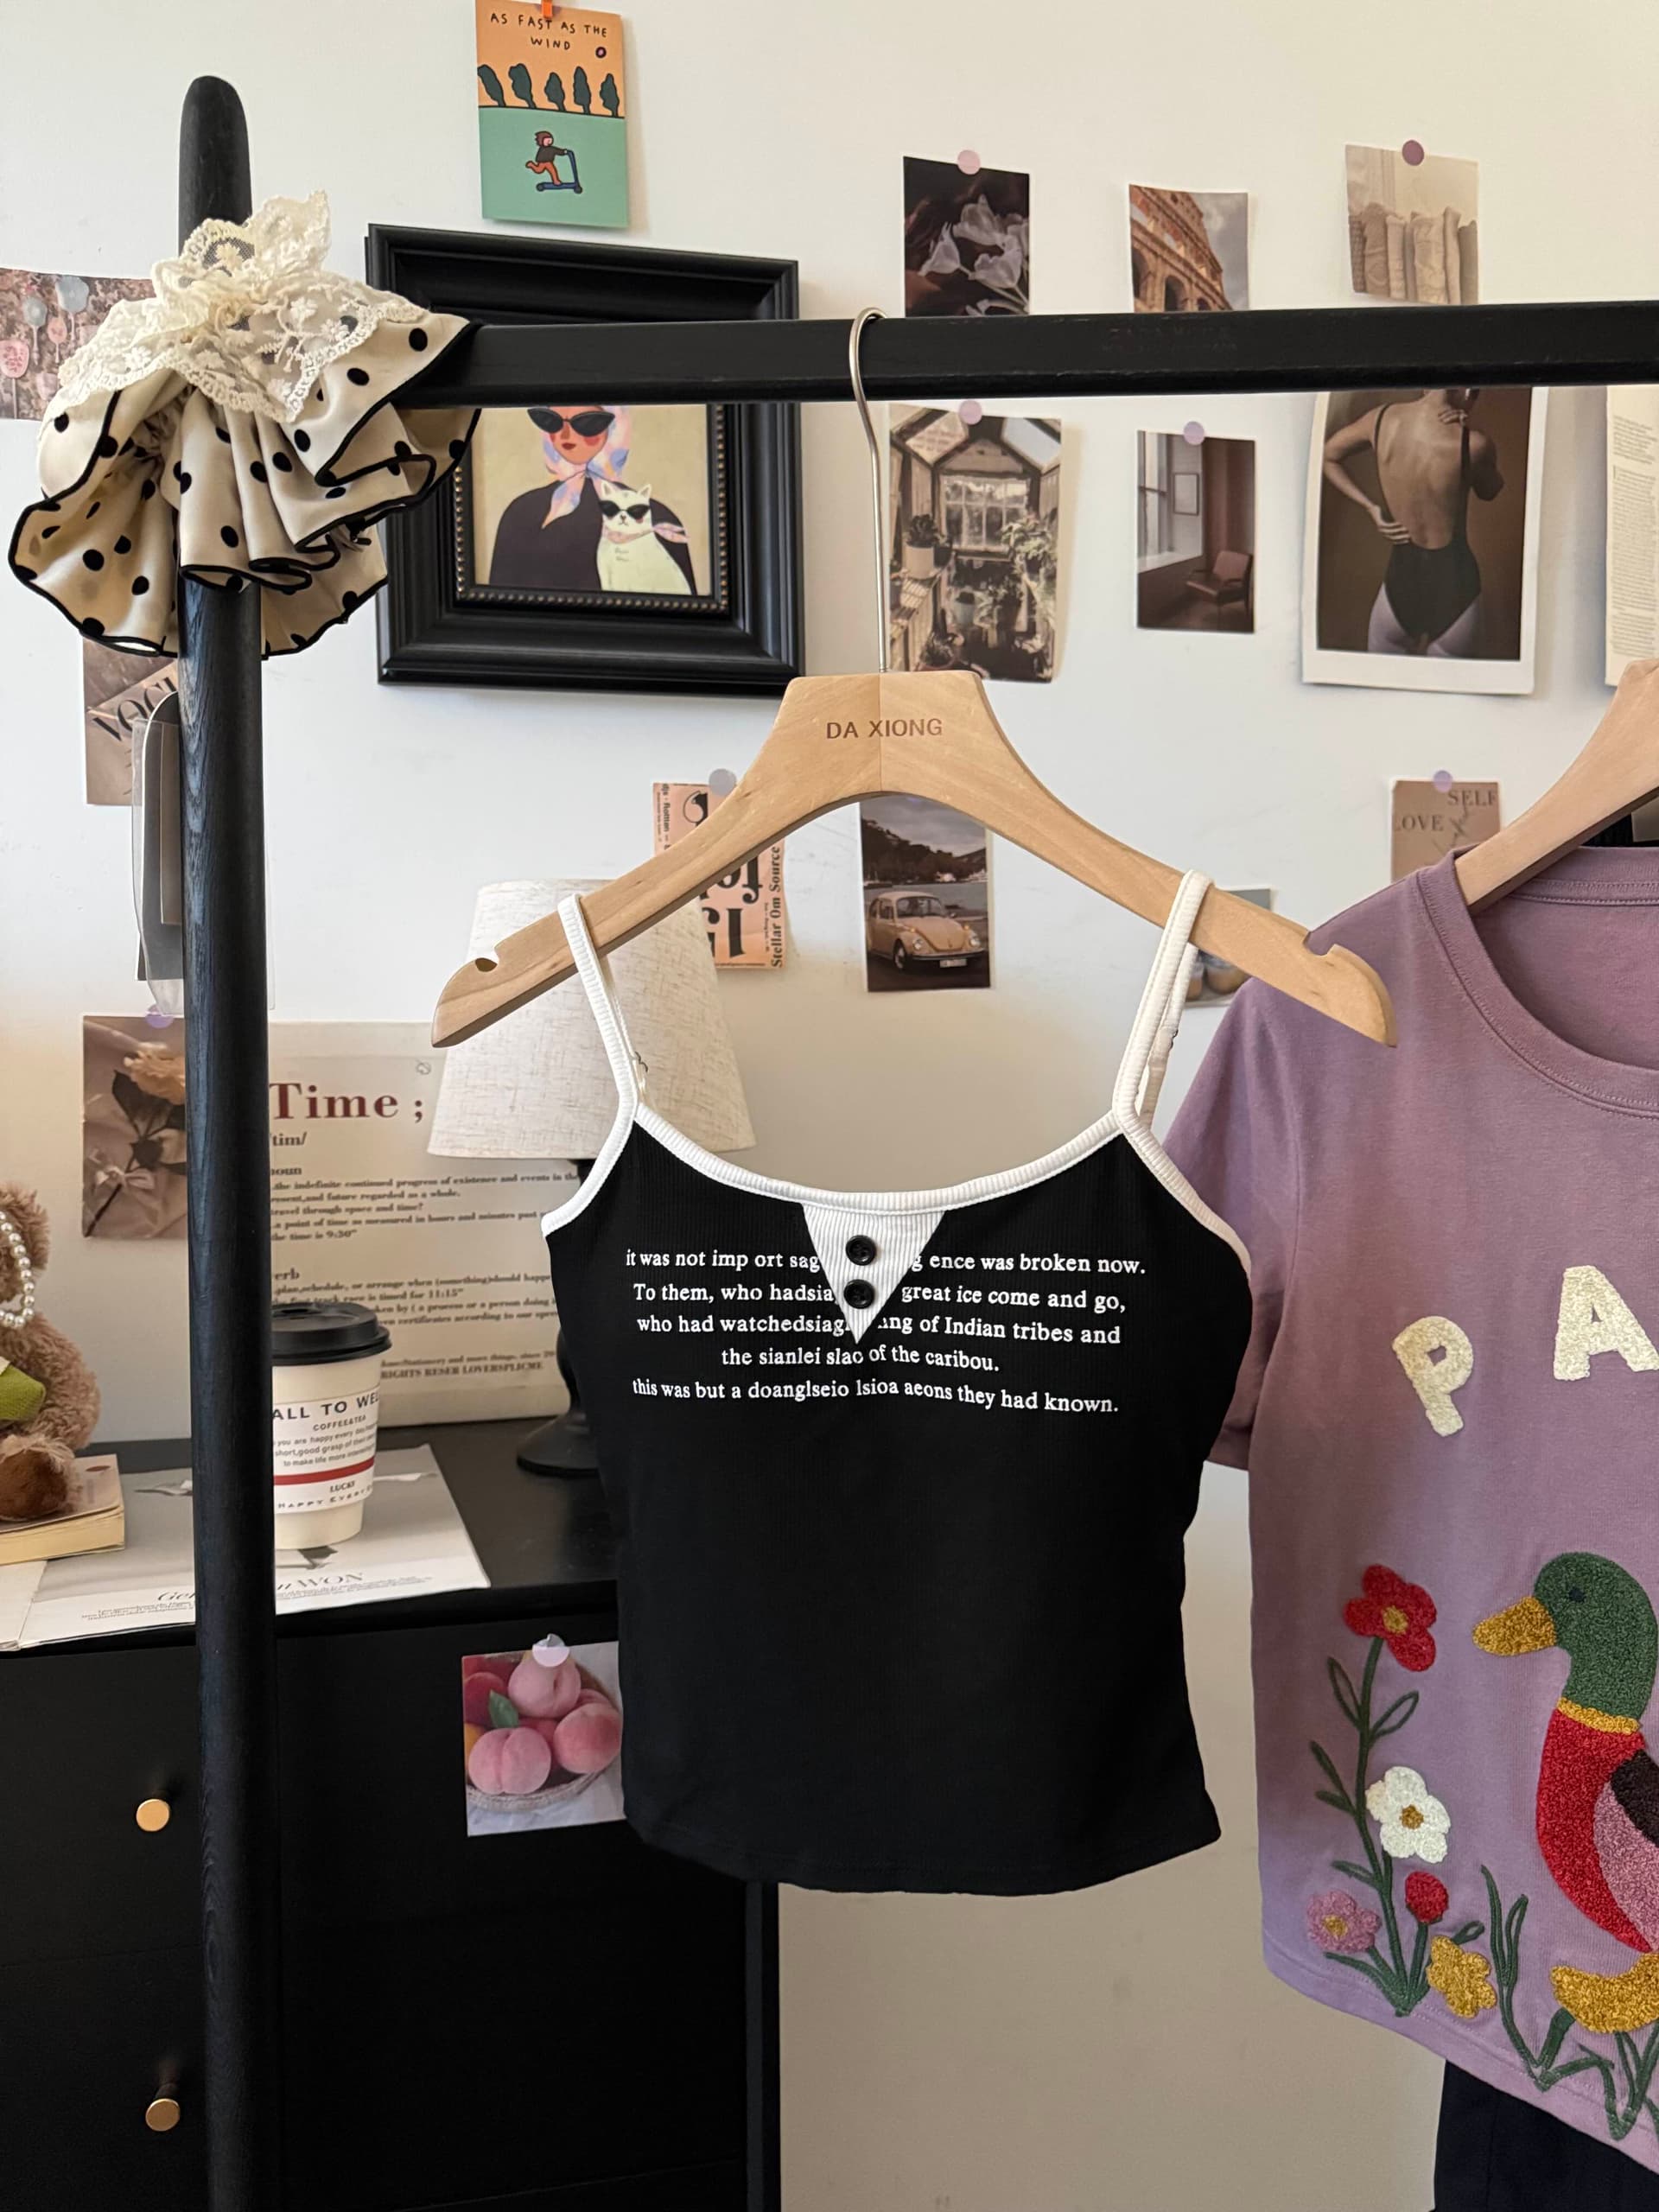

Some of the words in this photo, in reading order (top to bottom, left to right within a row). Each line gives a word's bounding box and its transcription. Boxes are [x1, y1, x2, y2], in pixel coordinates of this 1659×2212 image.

[491, 13, 508, 24] AS
[518, 15, 552, 30] FAST
[561, 22, 575, 34] AS
[584, 25, 607, 37] THE
[531, 37, 570, 50] WIND
[826, 721, 859, 739] DA
[868, 718, 943, 738] XIONG
[1447, 790, 1496, 807] SELF
[770, 847, 780, 893] Source
[770, 897, 781, 918] Om
[771, 923, 783, 968] Stellar
[269, 1083, 398, 1120] Time
[346, 1179, 392, 1188] continued
[396, 1178, 437, 1187] progress
[327, 1192, 357, 1201] future
[360, 1191, 404, 1200] regarded
[302, 1205, 342, 1214] through
[375, 1203, 394, 1211] and
[284, 1219, 310, 1230] point
[314, 1217, 324, 1227] of
[365, 1216, 412, 1224] measured
[428, 1214, 454, 1223] hours
[458, 1212, 475, 1221] and
[518, 1211, 537, 1220] past
[289, 1231, 312, 1240] time
[626, 1249, 636, 1266] it
[640, 1254, 670, 1266] was
[676, 1252, 705, 1266] not
[712, 1249, 748, 1271] imp
[755, 1254, 783, 1267] ort
[930, 1255, 975, 1269] ence
[981, 1258, 1014, 1270] was
[1020, 1253, 1090, 1272] broken
[1098, 1260, 1145, 1274] now.
[366, 1280, 404, 1289] arrange
[408, 1277, 432, 1287] when
[379, 1292, 407, 1300] timed
[410, 1290, 426, 1299] for
[633, 1283, 655, 1300] To
[662, 1284, 714, 1303] them,
[721, 1284, 762, 1300] who
[770, 1284, 838, 1304] hadsia
[902, 1287, 950, 1302] great
[957, 1286, 982, 1303] ice
[988, 1291, 1039, 1306] come
[1048, 1290, 1086, 1307] and
[1094, 1296, 1125, 1313] go,
[397, 1304, 409, 1313] by
[428, 1303, 463, 1313] process
[489, 1300, 520, 1310] person
[398, 1314, 451, 1325] certificates
[454, 1312, 501, 1323] according
[504, 1311, 513, 1319] to
[637, 1315, 671, 1332] who
[679, 1315, 714, 1332] had
[720, 1315, 851, 1337] watchedsiag
[920, 1316, 939, 1332] of
[944, 1317, 1006, 1338] Indian
[1013, 1322, 1072, 1342] tribes
[1081, 1326, 1120, 1344] and
[448, 1354, 464, 1363] and
[721, 1348, 752, 1364] the
[760, 1347, 820, 1364] sianlei
[869, 1344, 887, 1361] of
[892, 1345, 919, 1363] the
[925, 1350, 999, 1371] caribou.
[381, 1368, 422, 1379] RIGHTS
[632, 1378, 658, 1395] this
[661, 1384, 690, 1398] was
[695, 1382, 725, 1398] but
[732, 1387, 741, 1398] a
[748, 1380, 849, 1402] doanglseio
[905, 1382, 952, 1400] aeons
[957, 1385, 995, 1409] they
[1001, 1389, 1038, 1409] had
[1045, 1392, 1117, 1412] known.
[272, 1407, 310, 1420] ALL
[321, 1401, 347, 1415] TO
[313, 1414, 366, 1431] COFFEE&TEA
[310, 1434, 334, 1445] happy
[334, 1431, 353, 1440] every
[321, 1443, 343, 1454] grasp
[346, 1440, 353, 1448] of
[293, 1458, 313, 1466] make
[278, 1499, 324, 1509] HAPPY
